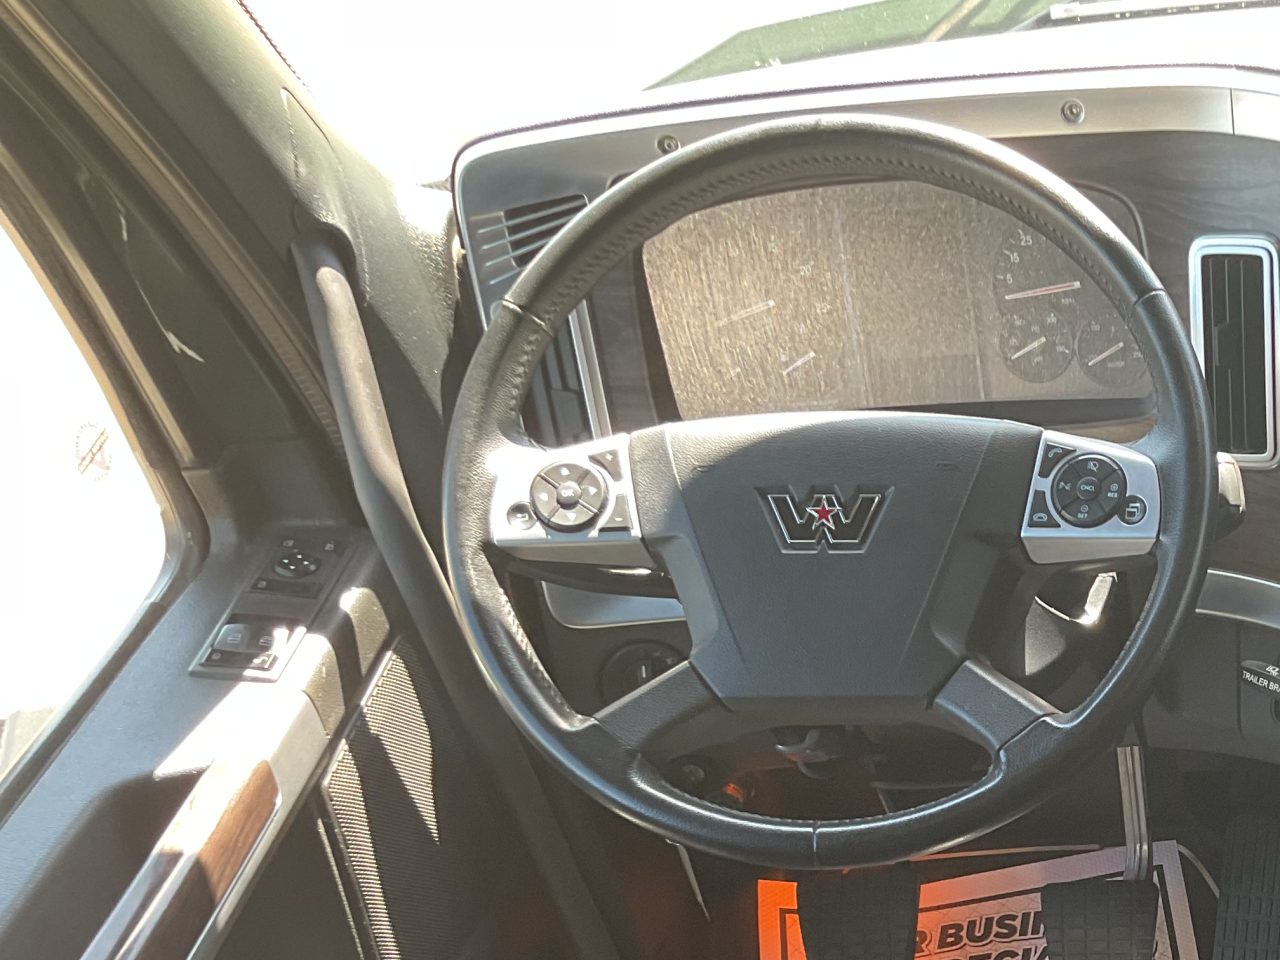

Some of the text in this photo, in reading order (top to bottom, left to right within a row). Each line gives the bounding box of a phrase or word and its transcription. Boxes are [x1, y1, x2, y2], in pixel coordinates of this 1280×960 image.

[561, 488, 575, 497] OK
[1242, 670, 1269, 689] TRAILER
[936, 909, 1045, 951] BUSI
